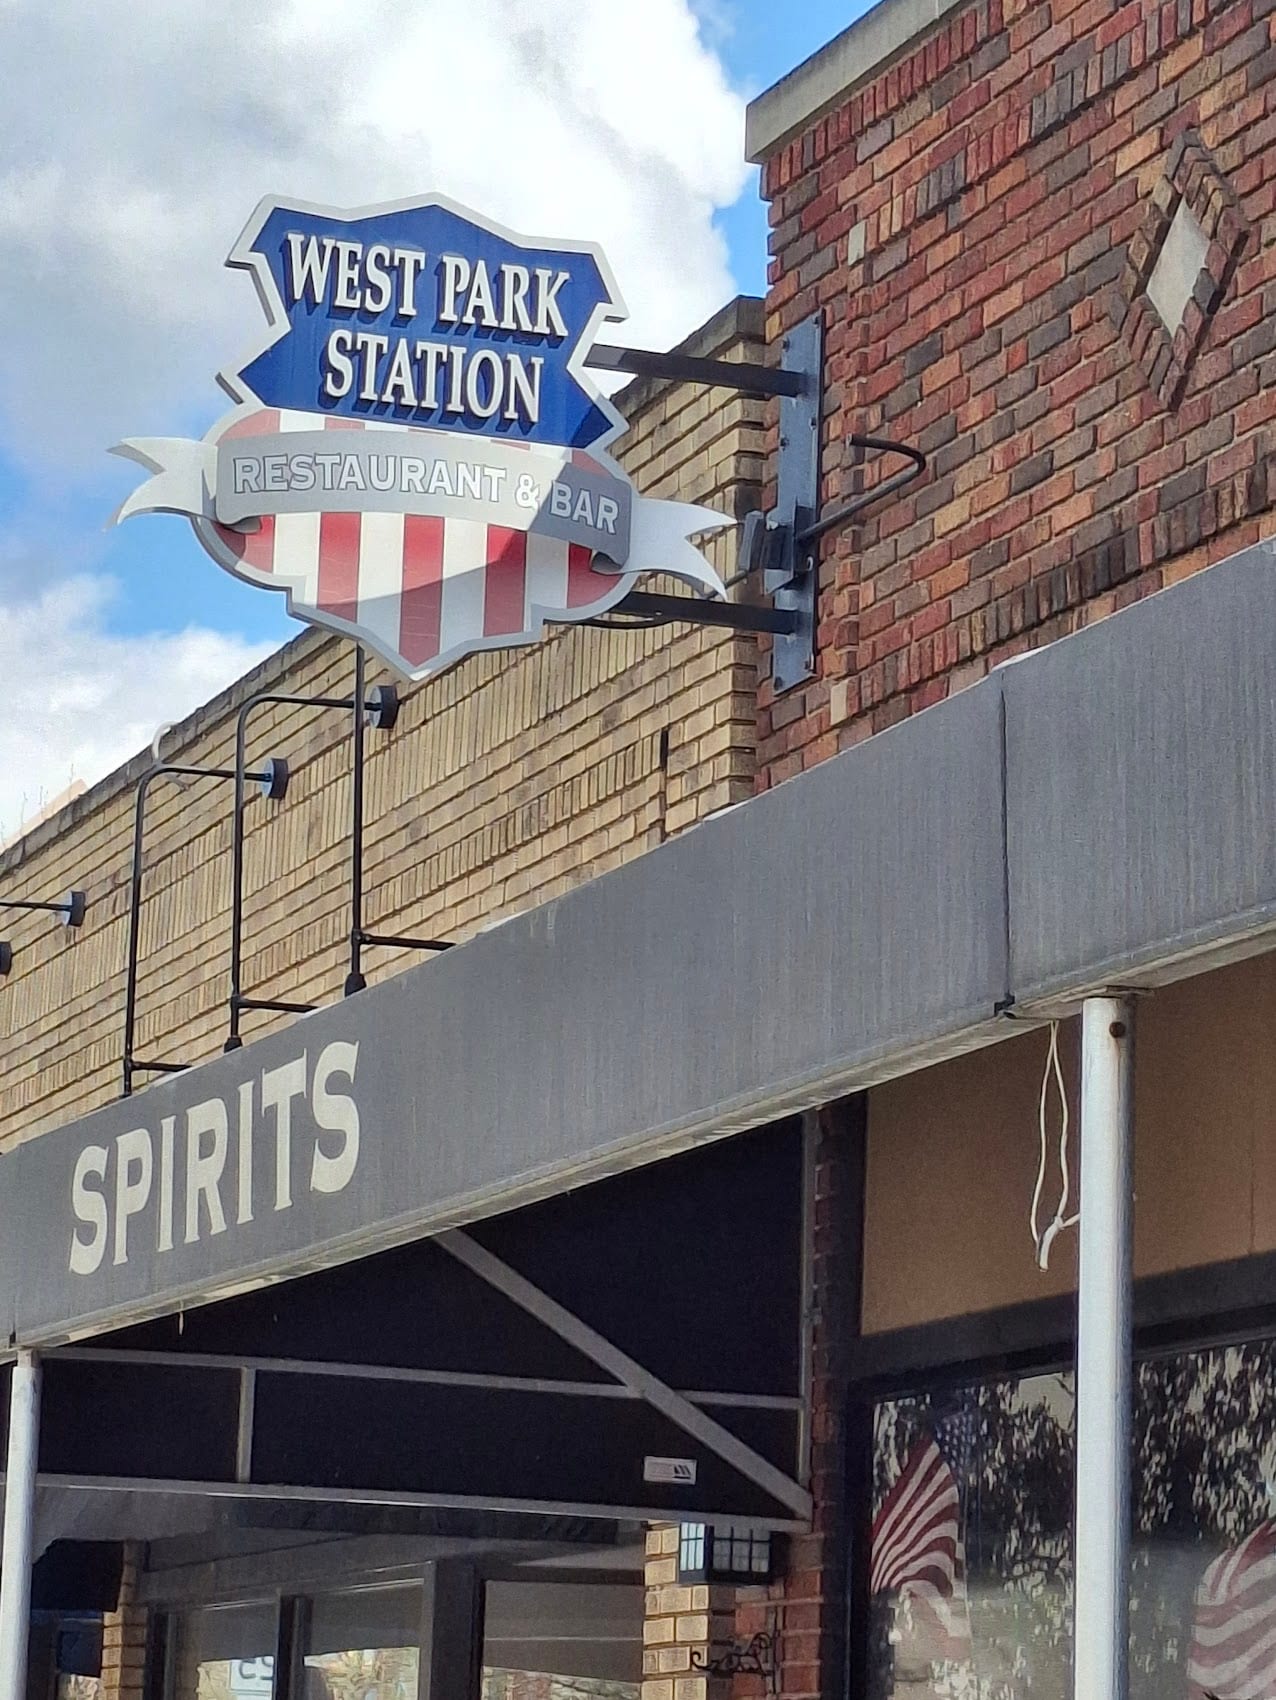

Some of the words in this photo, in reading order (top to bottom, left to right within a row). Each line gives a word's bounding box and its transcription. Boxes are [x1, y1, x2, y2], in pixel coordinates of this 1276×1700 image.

[287, 233, 426, 316] WEST
[440, 255, 570, 336] PARK
[325, 329, 545, 423] STATION
[232, 453, 506, 503] RESTAURANT
[513, 474, 541, 510] &
[549, 480, 619, 534] BAR
[68, 1040, 361, 1276] SPIRITS
